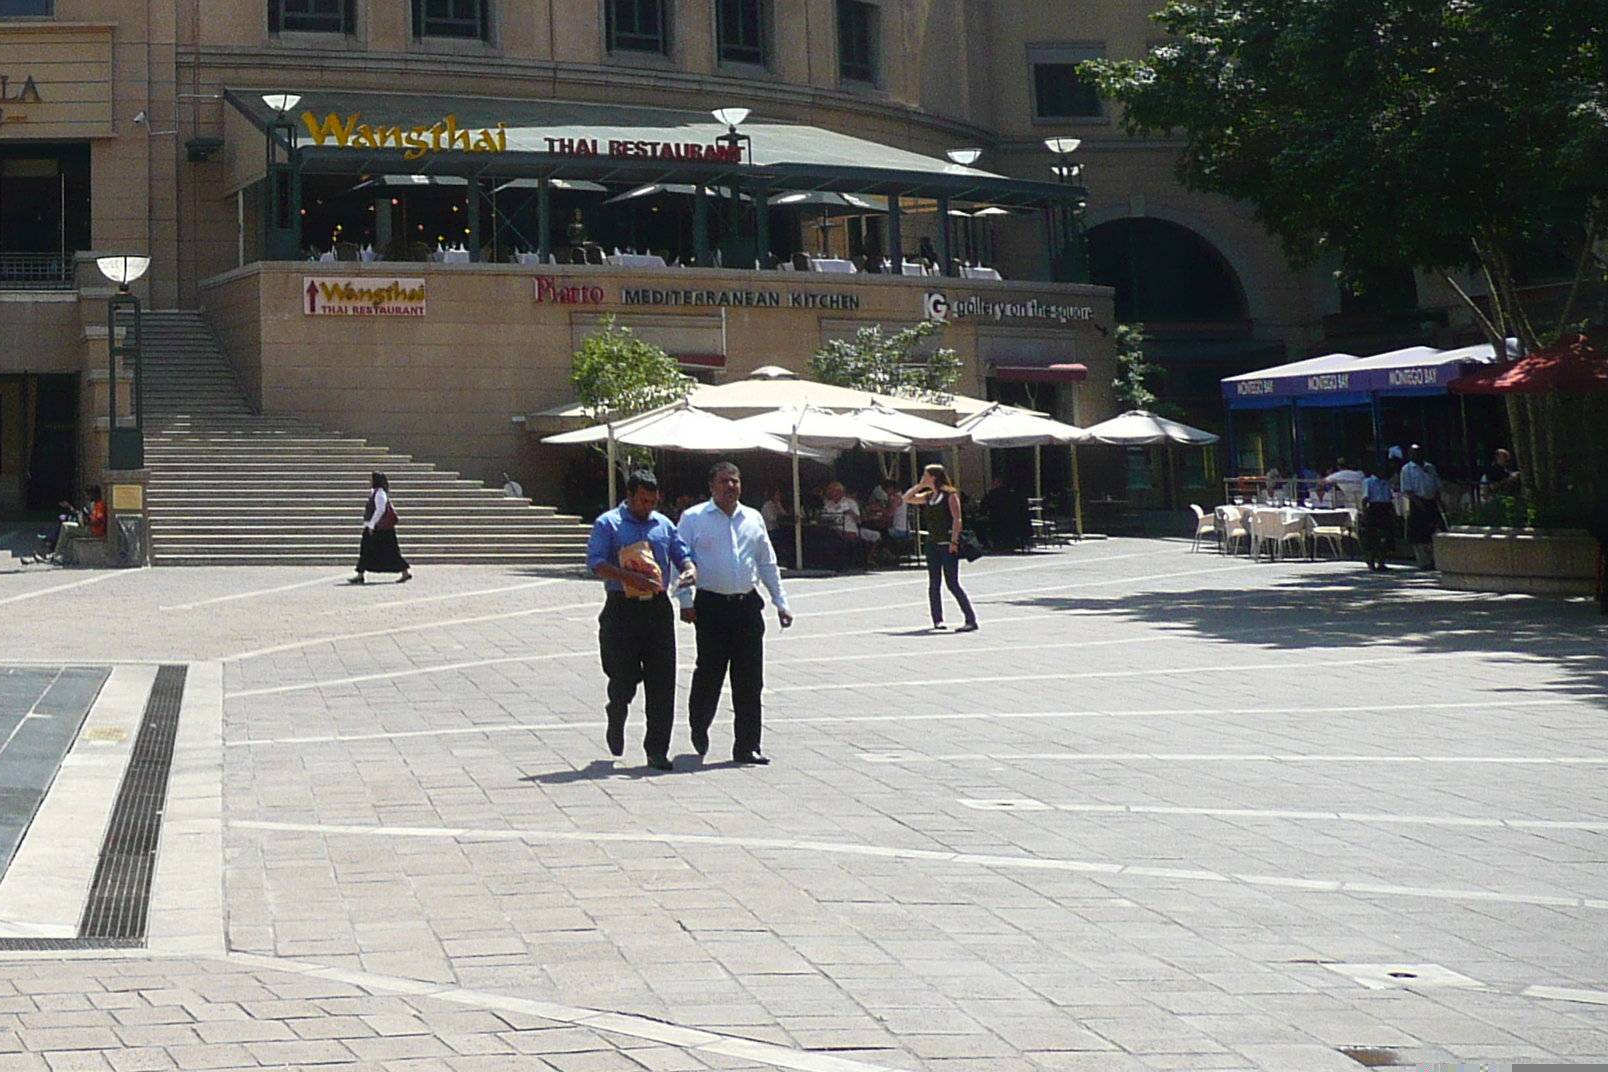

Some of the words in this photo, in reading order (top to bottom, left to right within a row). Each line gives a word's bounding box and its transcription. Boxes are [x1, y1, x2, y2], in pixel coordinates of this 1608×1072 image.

[301, 111, 507, 160] Wangthai
[544, 137, 599, 157] THAI
[608, 139, 745, 162] RESTAURANT
[319, 280, 425, 306] Wangthai
[533, 276, 604, 304] Piatto
[622, 288, 780, 308] MEDITERRANEAN
[789, 290, 860, 311] KITCHEN
[321, 305, 348, 315] THAI
[352, 305, 424, 315] RESTAURANT
[1008, 302, 1026, 316] on
[1389, 368, 1423, 385] MONTEGO
[1424, 367, 1438, 384] BAY
